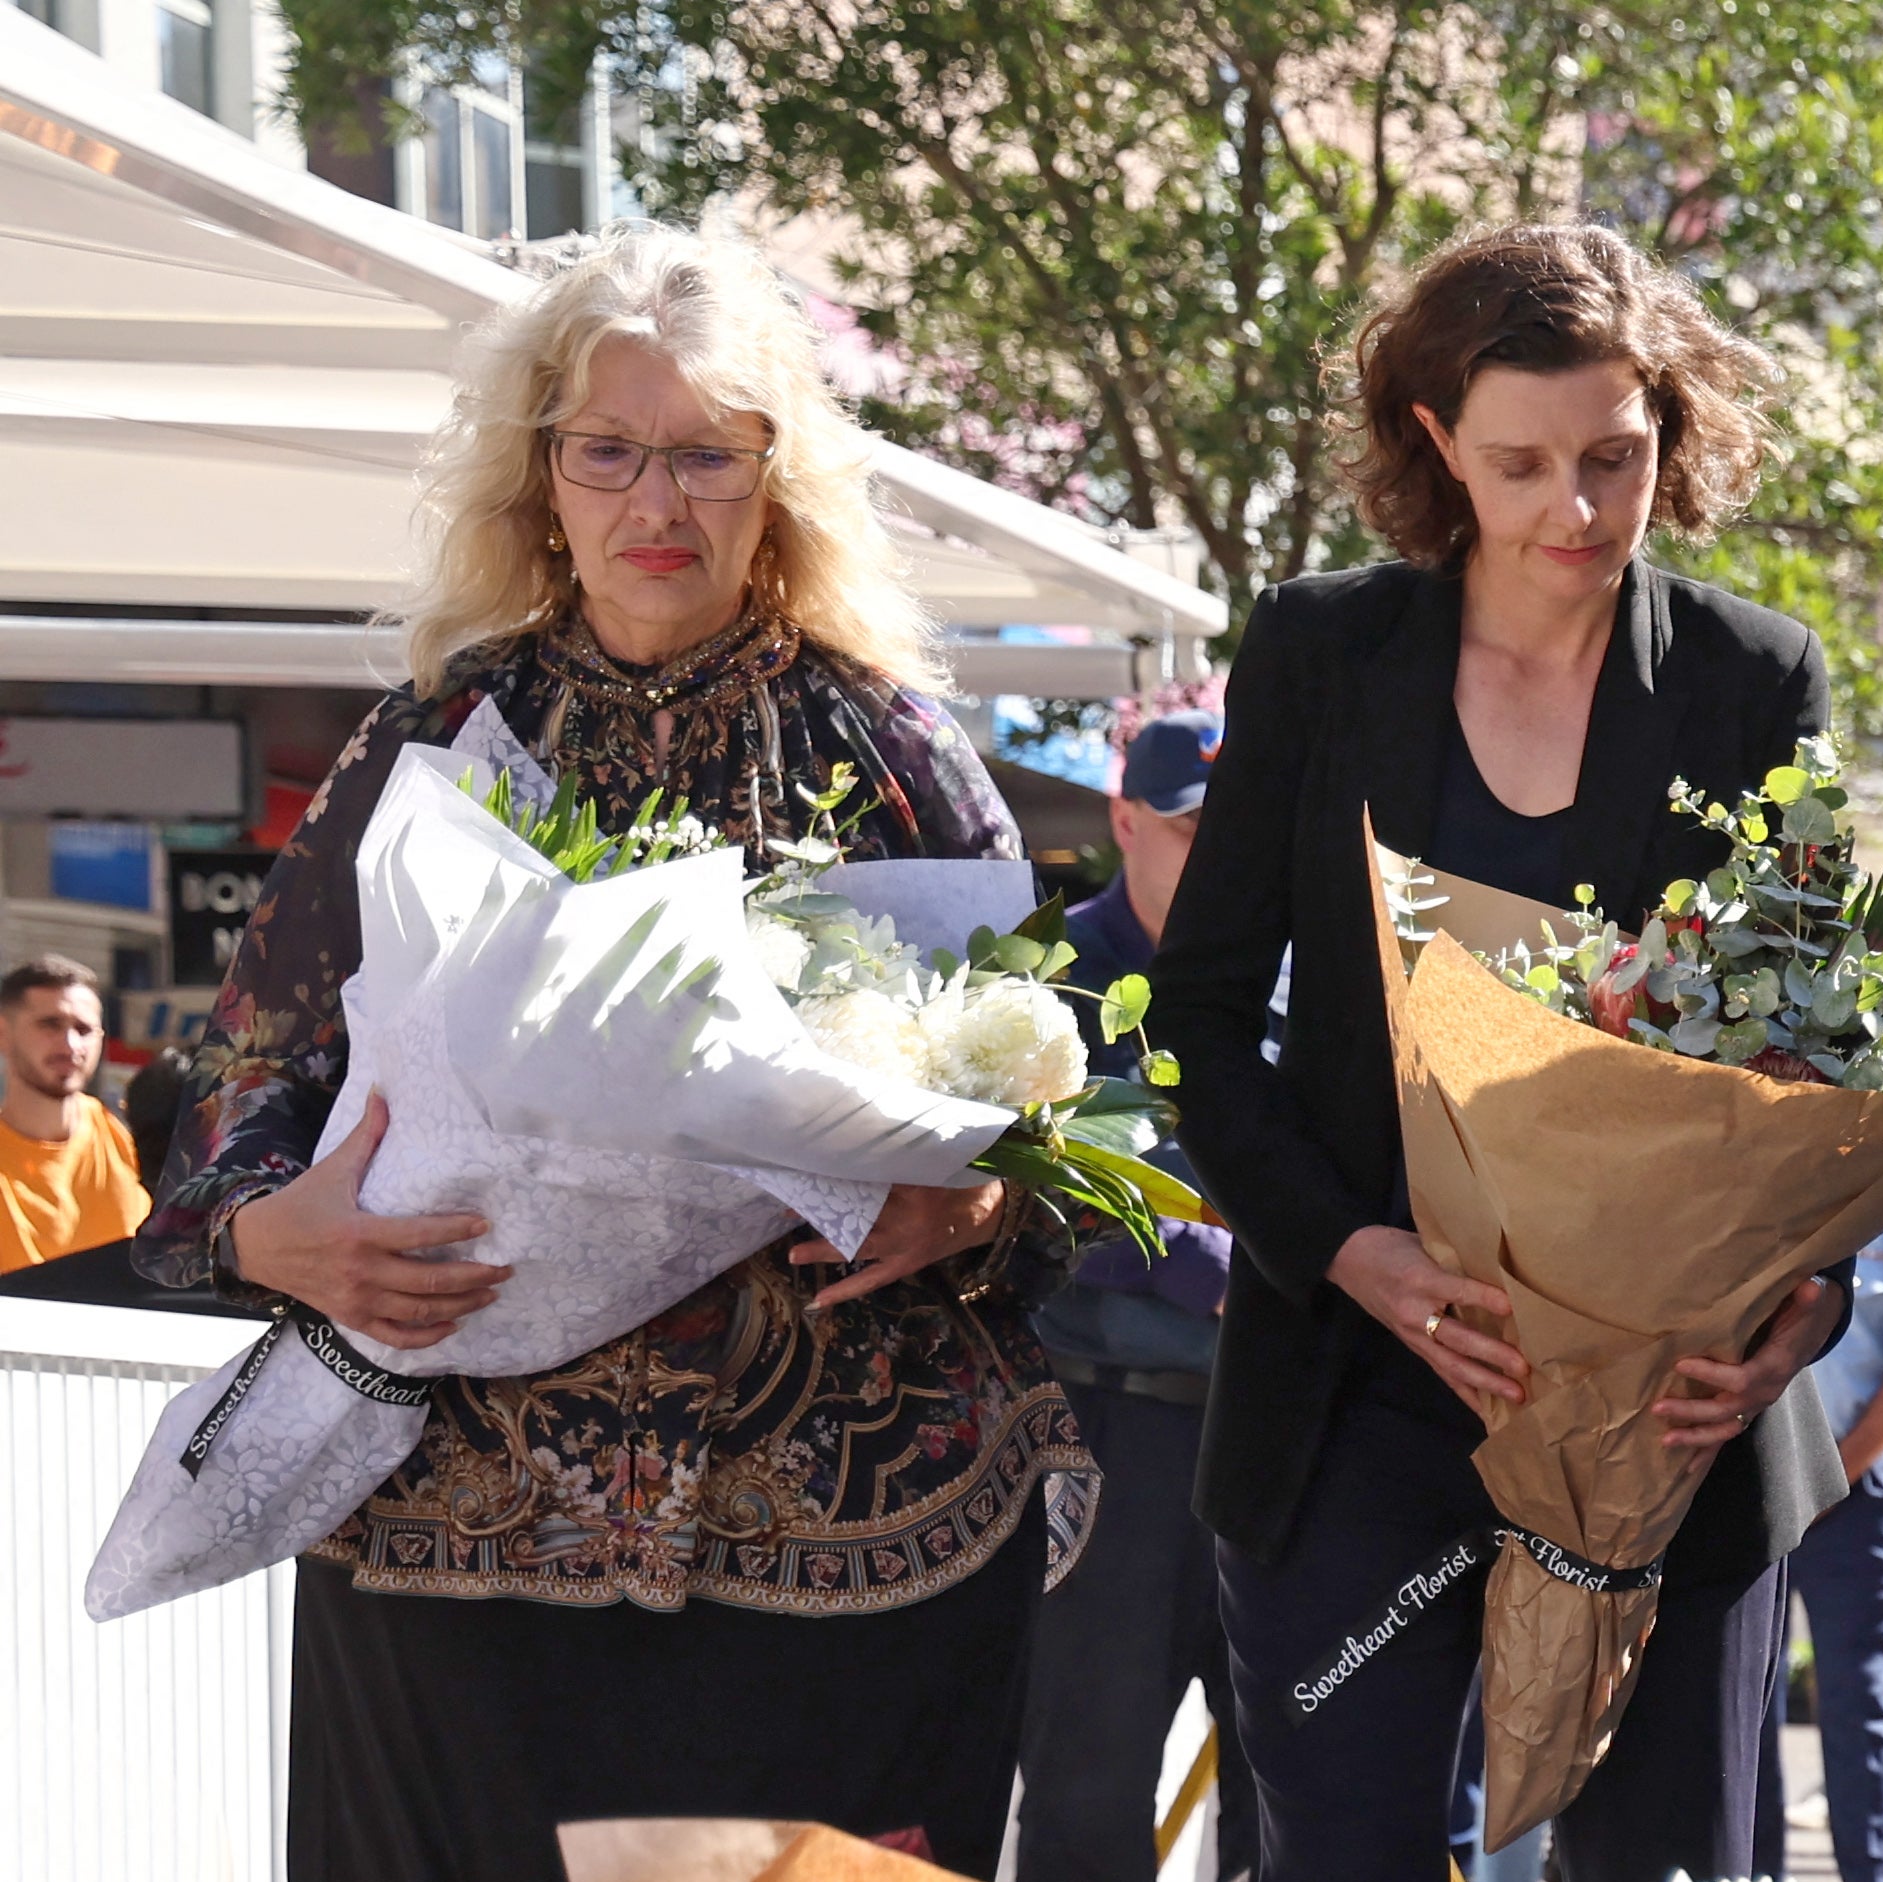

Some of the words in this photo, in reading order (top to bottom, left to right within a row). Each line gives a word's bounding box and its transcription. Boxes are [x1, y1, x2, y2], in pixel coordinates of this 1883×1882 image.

[189, 1329, 280, 1460] Sweetheart
[307, 1323, 428, 1406] Sweetheart
[1530, 1535, 1610, 1592] Florist
[1293, 1606, 1408, 1713] Sweetheart
[1398, 1544, 1477, 1610] Florist
